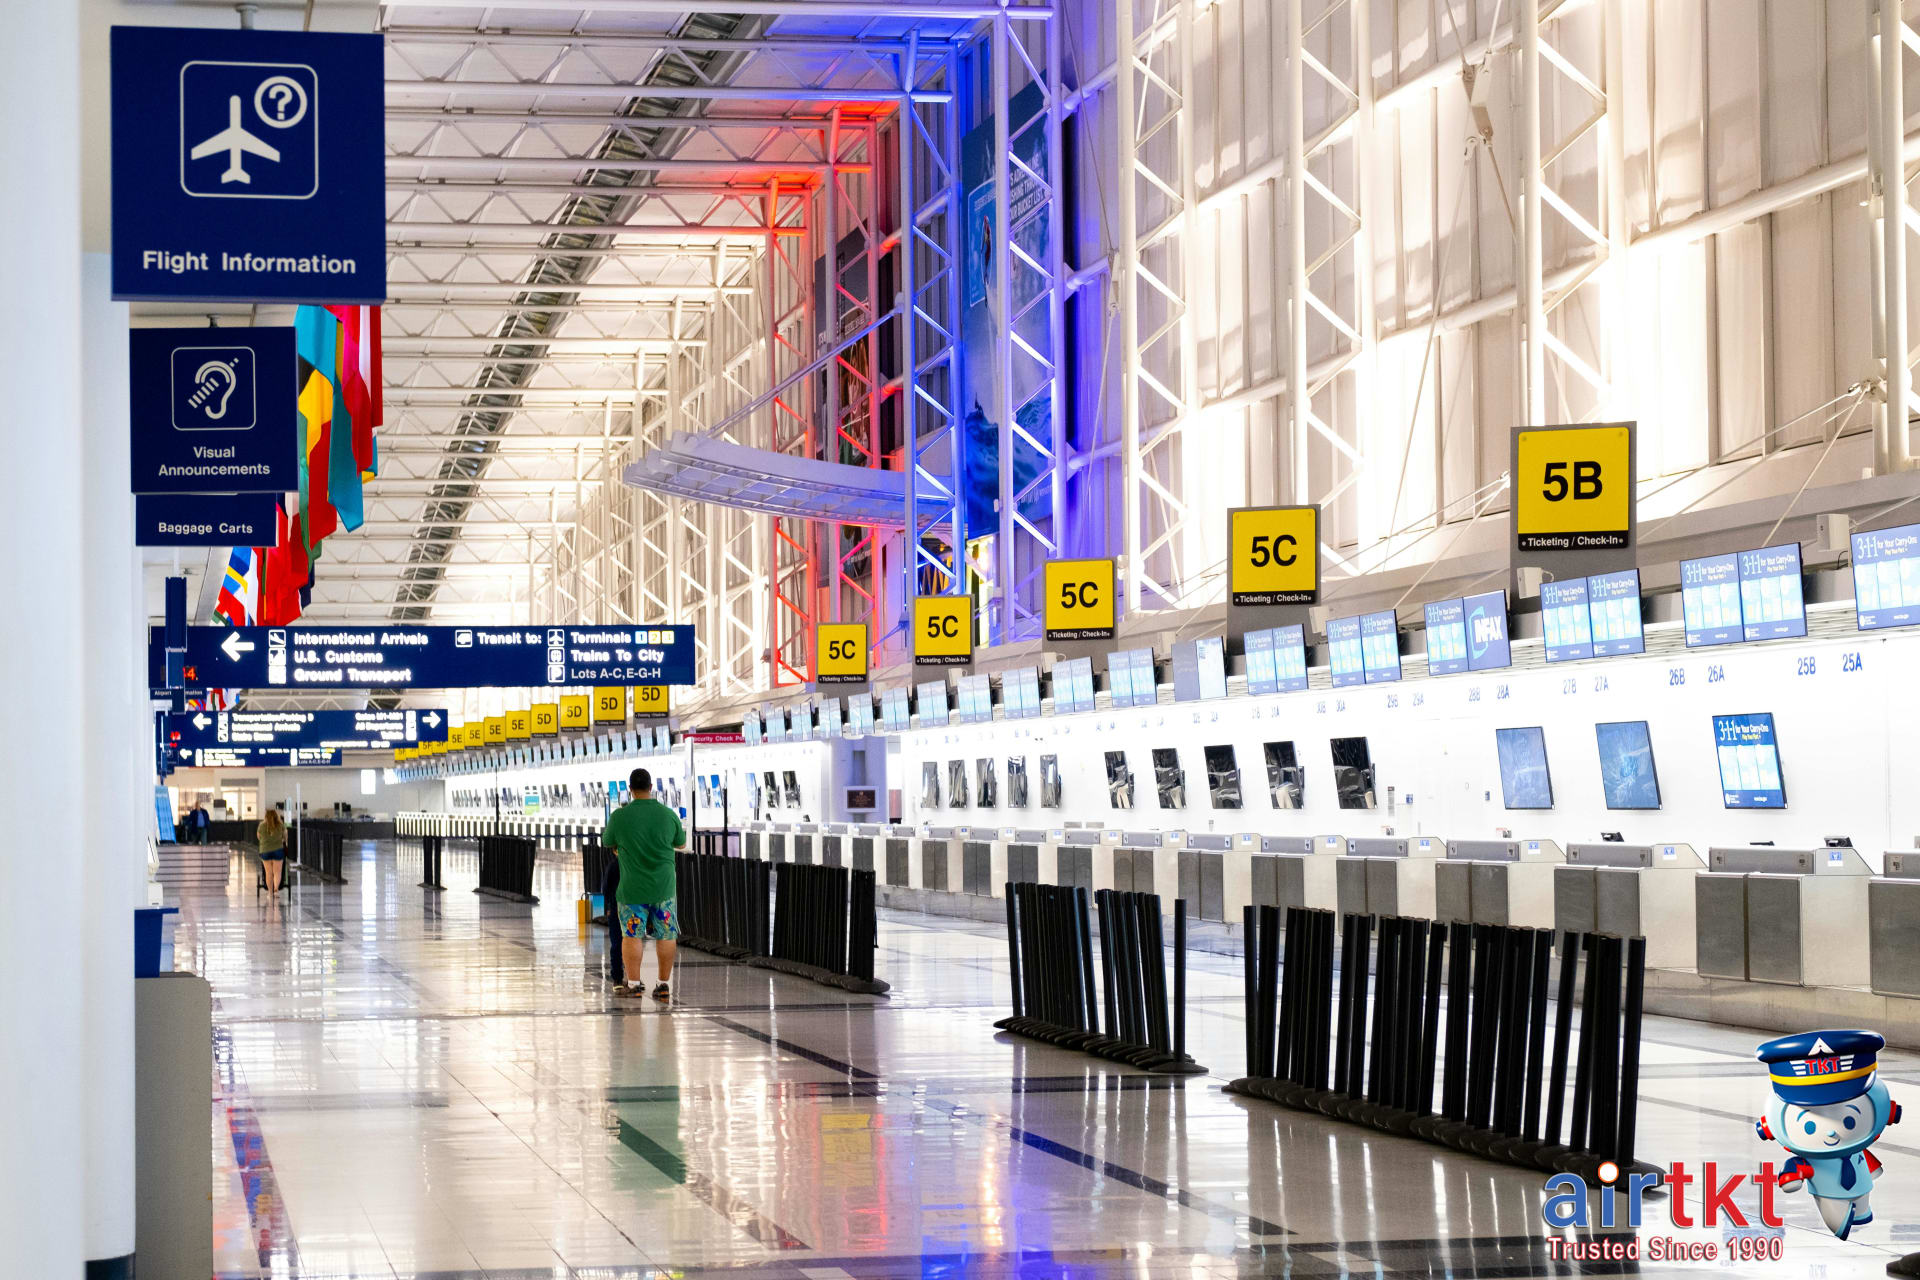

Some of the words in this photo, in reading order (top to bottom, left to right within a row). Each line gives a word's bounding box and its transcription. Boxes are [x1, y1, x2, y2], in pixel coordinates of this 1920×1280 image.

[143, 250, 208, 274] Flight
[222, 252, 356, 274] Information
[193, 446, 235, 458] Visual
[158, 463, 270, 476] Announcements
[1542, 461, 1603, 502] 5B
[158, 522, 213, 534] Baggage
[219, 523, 253, 534] Carts
[1528, 537, 1569, 548] Ticketing
[1577, 536, 1618, 546] Check-In
[1857, 536, 1878, 559] 3-1-1
[1250, 534, 1298, 567] 5C
[1743, 554, 1762, 576] 3-1-1
[1686, 562, 1703, 583] 3-1-1
[1061, 581, 1099, 609] 5C
[1545, 586, 1559, 604] 3-1-1
[1592, 578, 1607, 598] 3-1-1
[1240, 595, 1271, 605] Ticketing
[1277, 594, 1308, 603] Check-In
[927, 615, 958, 638] 5C
[1474, 616, 1503, 643] INFAX
[294, 633, 375, 645] International
[380, 632, 429, 645] Arrivals
[477, 632, 523, 644] Transit
[526, 632, 542, 644] to:
[571, 632, 632, 644] Terminals
[1052, 631, 1077, 640] Ticketing
[1082, 630, 1107, 638] Check-In
[571, 650, 610, 661] Trains
[615, 650, 633, 661] To
[638, 650, 664, 663] City
[828, 640, 856, 660] 5C
[294, 651, 320, 664] U.S.
[325, 651, 383, 663] Customs
[945, 656, 966, 664] Check-In
[1842, 652, 1863, 672] 25A
[1798, 656, 1816, 676] 25B
[294, 669, 342, 682] Ground
[348, 668, 411, 683] Transport
[571, 668, 597, 679] Lots
[1669, 668, 1685, 686] 26B
[1708, 665, 1725, 683] 26A
[1563, 679, 1576, 694] 27B
[1595, 673, 1609, 692] 27A
[641, 687, 660, 701] 5D
[1469, 687, 1481, 702] 28B
[1497, 685, 1510, 699] 28A
[601, 698, 618, 710] 5D
[1387, 694, 1398, 708] 29B
[567, 706, 582, 717] 5D
[512, 720, 524, 730] 5E
[537, 714, 551, 724] 5D
[469, 729, 481, 739] 5E
[489, 725, 501, 735] 5E
[1719, 720, 1737, 741] 3-1-1
[1741, 724, 1749, 733] Your
[452, 734, 462, 743] 5E
